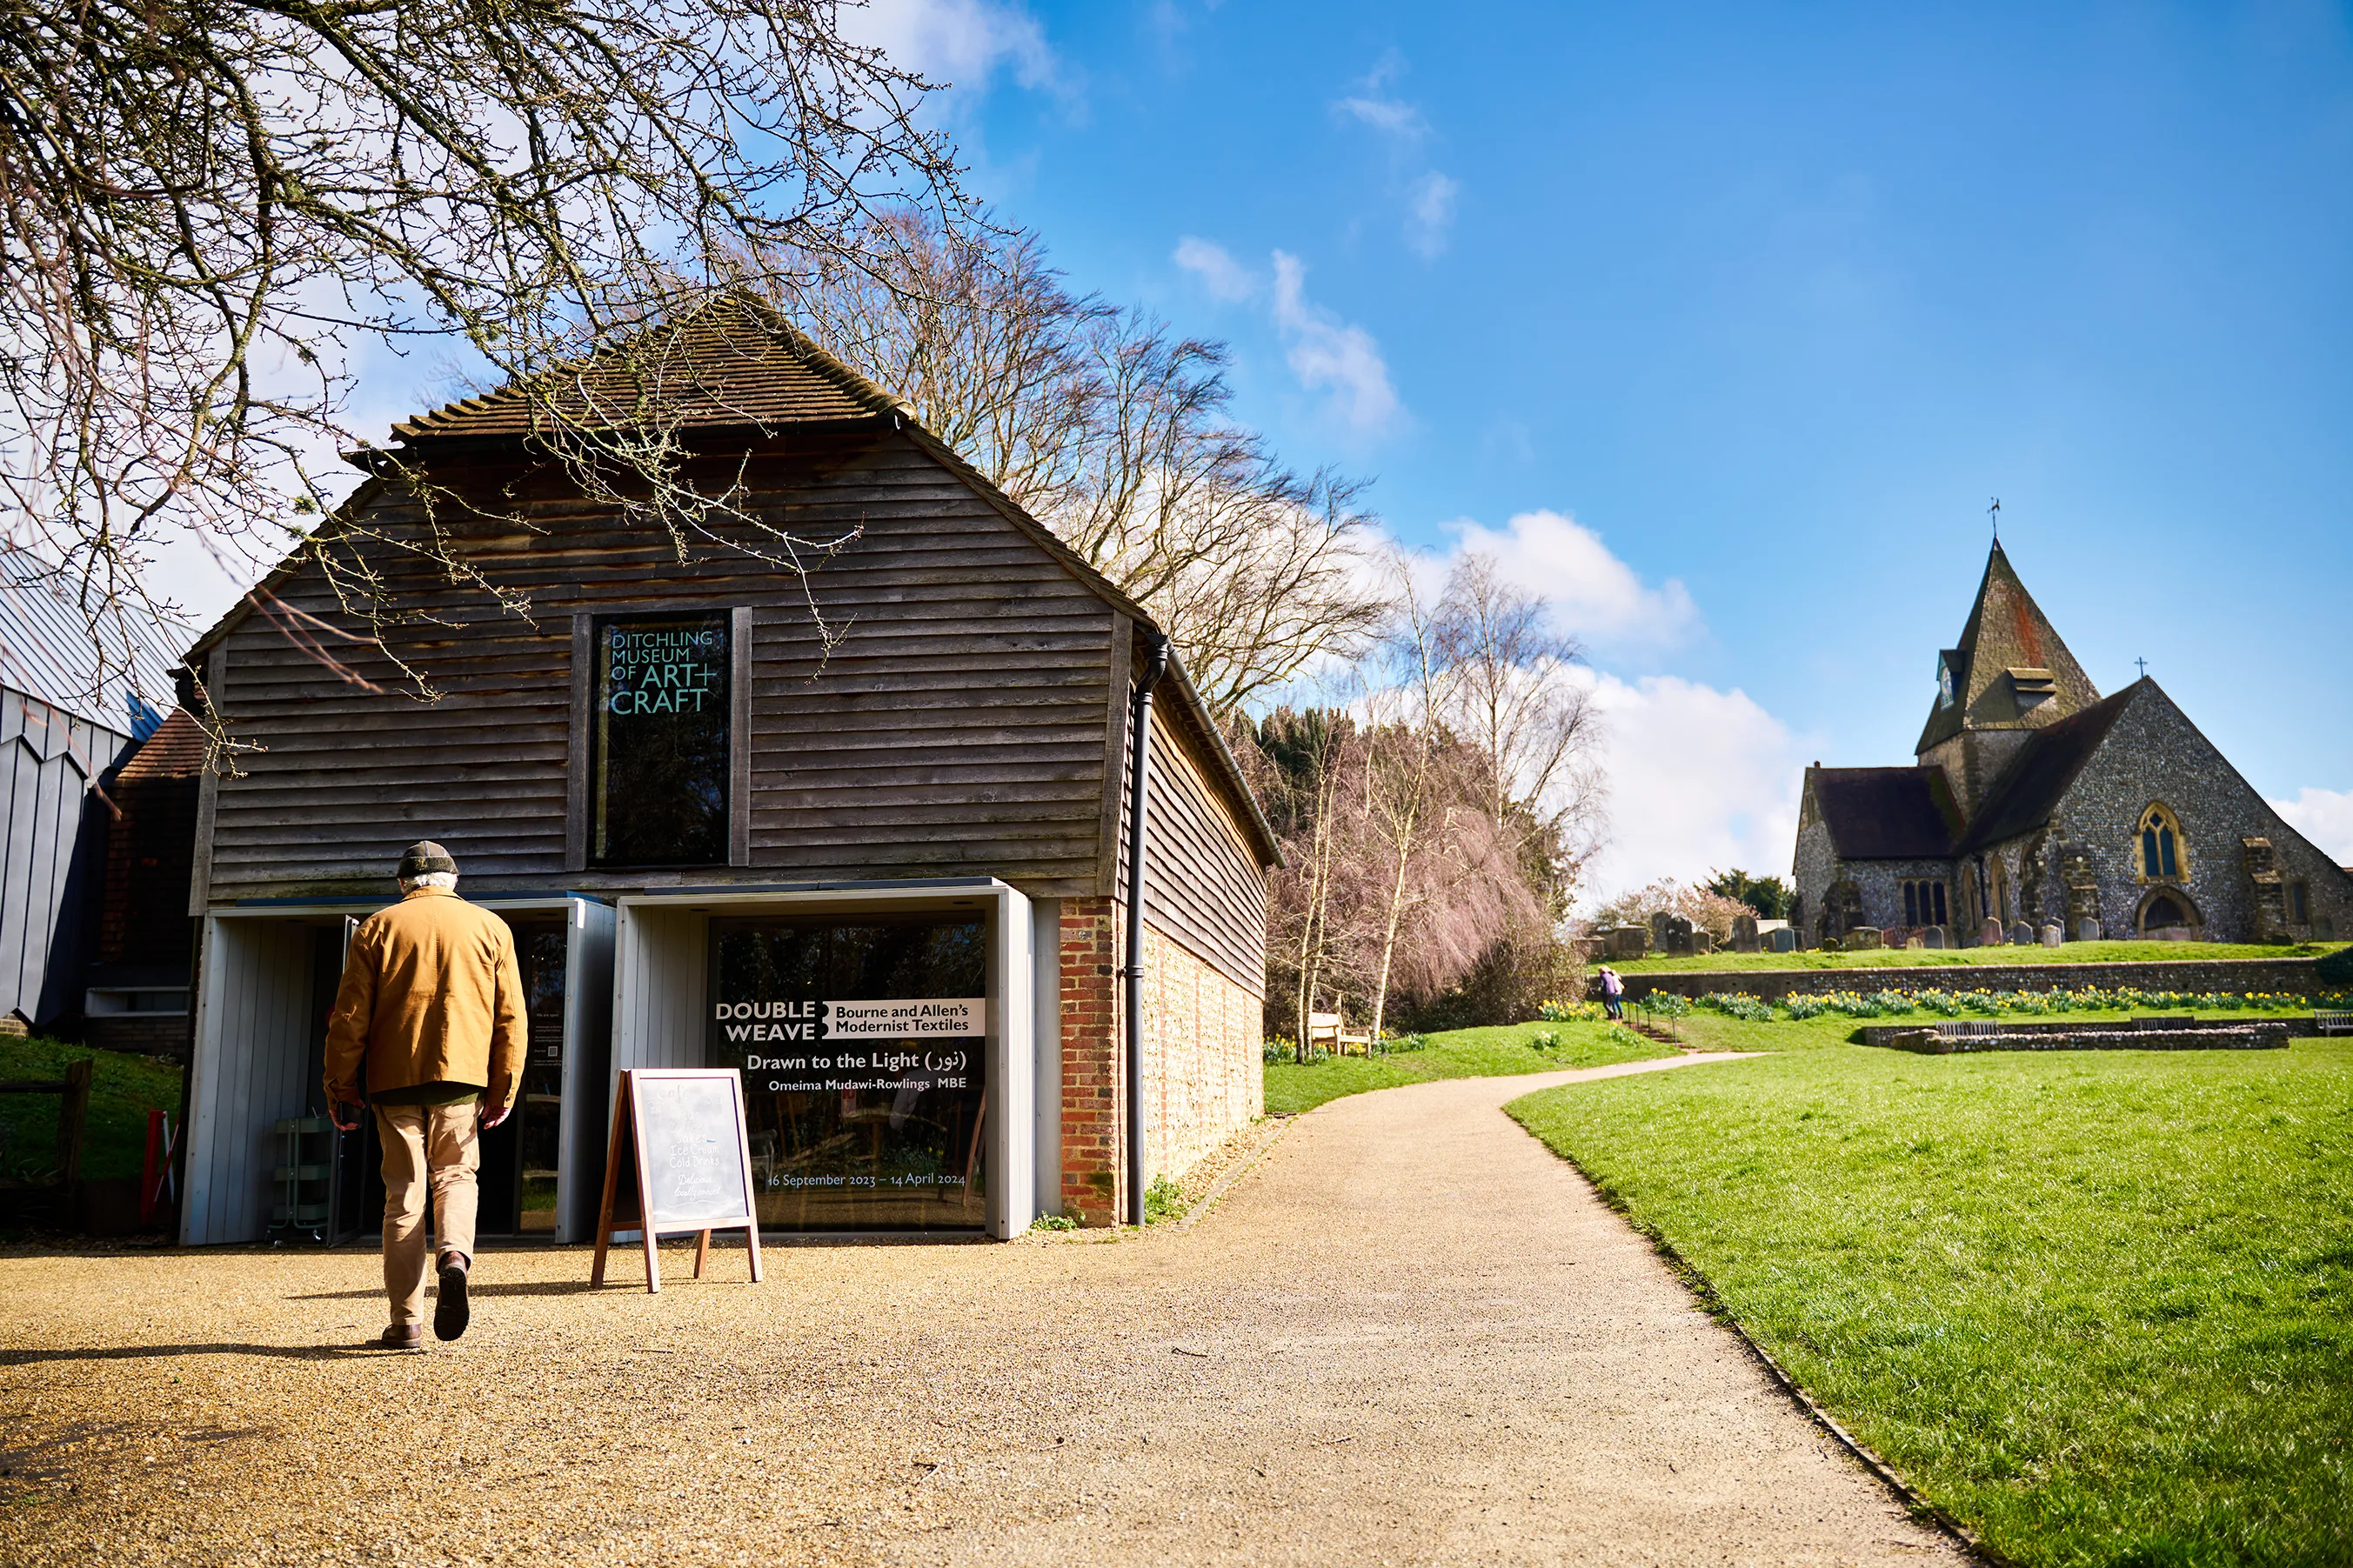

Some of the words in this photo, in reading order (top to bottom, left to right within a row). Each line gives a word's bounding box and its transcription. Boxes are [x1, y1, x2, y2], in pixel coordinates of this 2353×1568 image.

[612, 631, 712, 649] DITCHLING
[612, 648, 690, 664] MUSEUM
[611, 666, 636, 680] OF
[611, 689, 708, 715] CRAFT
[716, 1002, 815, 1020] DOUBLE
[836, 1006, 888, 1018] Bourne
[891, 1005, 917, 1018] and
[725, 1023, 815, 1042] WEAVE
[836, 1020, 909, 1033] Modernist
[912, 1019, 969, 1031] Textiles
[747, 1054, 806, 1070] Drawn
[812, 1056, 831, 1069] to
[837, 1053, 866, 1068] the
[872, 1052, 919, 1072] Light
[769, 1080, 821, 1091] Omeima
[826, 1078, 930, 1092] Mudawi-Rowlings
[938, 1078, 966, 1088] MBE
[670, 1145, 689, 1156] Ice
[690, 1144, 719, 1156] Cream
[670, 1157, 690, 1169] Cold
[693, 1156, 720, 1167] Drinks
[768, 1175, 779, 1186] 16
[783, 1174, 846, 1188] September
[850, 1176, 876, 1188] 2023
[891, 1176, 903, 1188] 14
[906, 1173, 934, 1186] April
[938, 1175, 966, 1187] 2024
